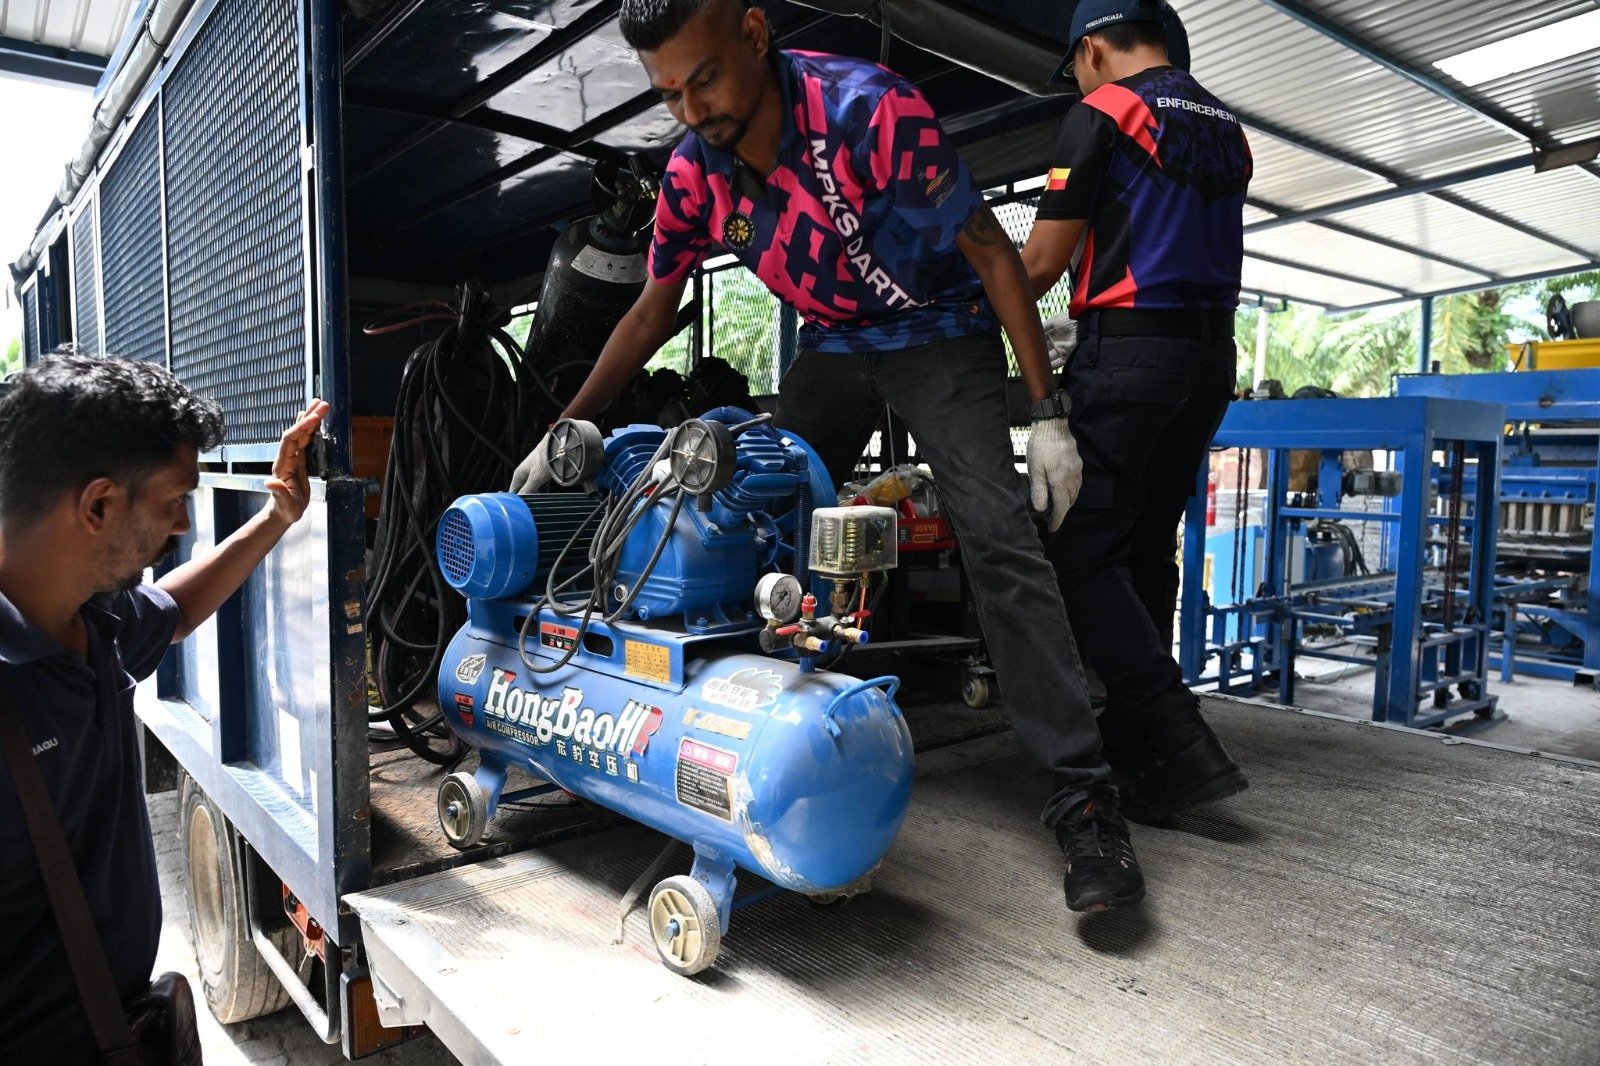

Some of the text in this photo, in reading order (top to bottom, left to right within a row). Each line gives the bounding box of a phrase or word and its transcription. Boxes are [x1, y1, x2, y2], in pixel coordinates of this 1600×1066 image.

[1156, 97, 1238, 124] ENFORCEMENT
[809, 138, 859, 238] MPKS
[486, 718, 540, 746] AIR COMPRESSOR
[556, 739, 640, 783] 宏豹空压机
